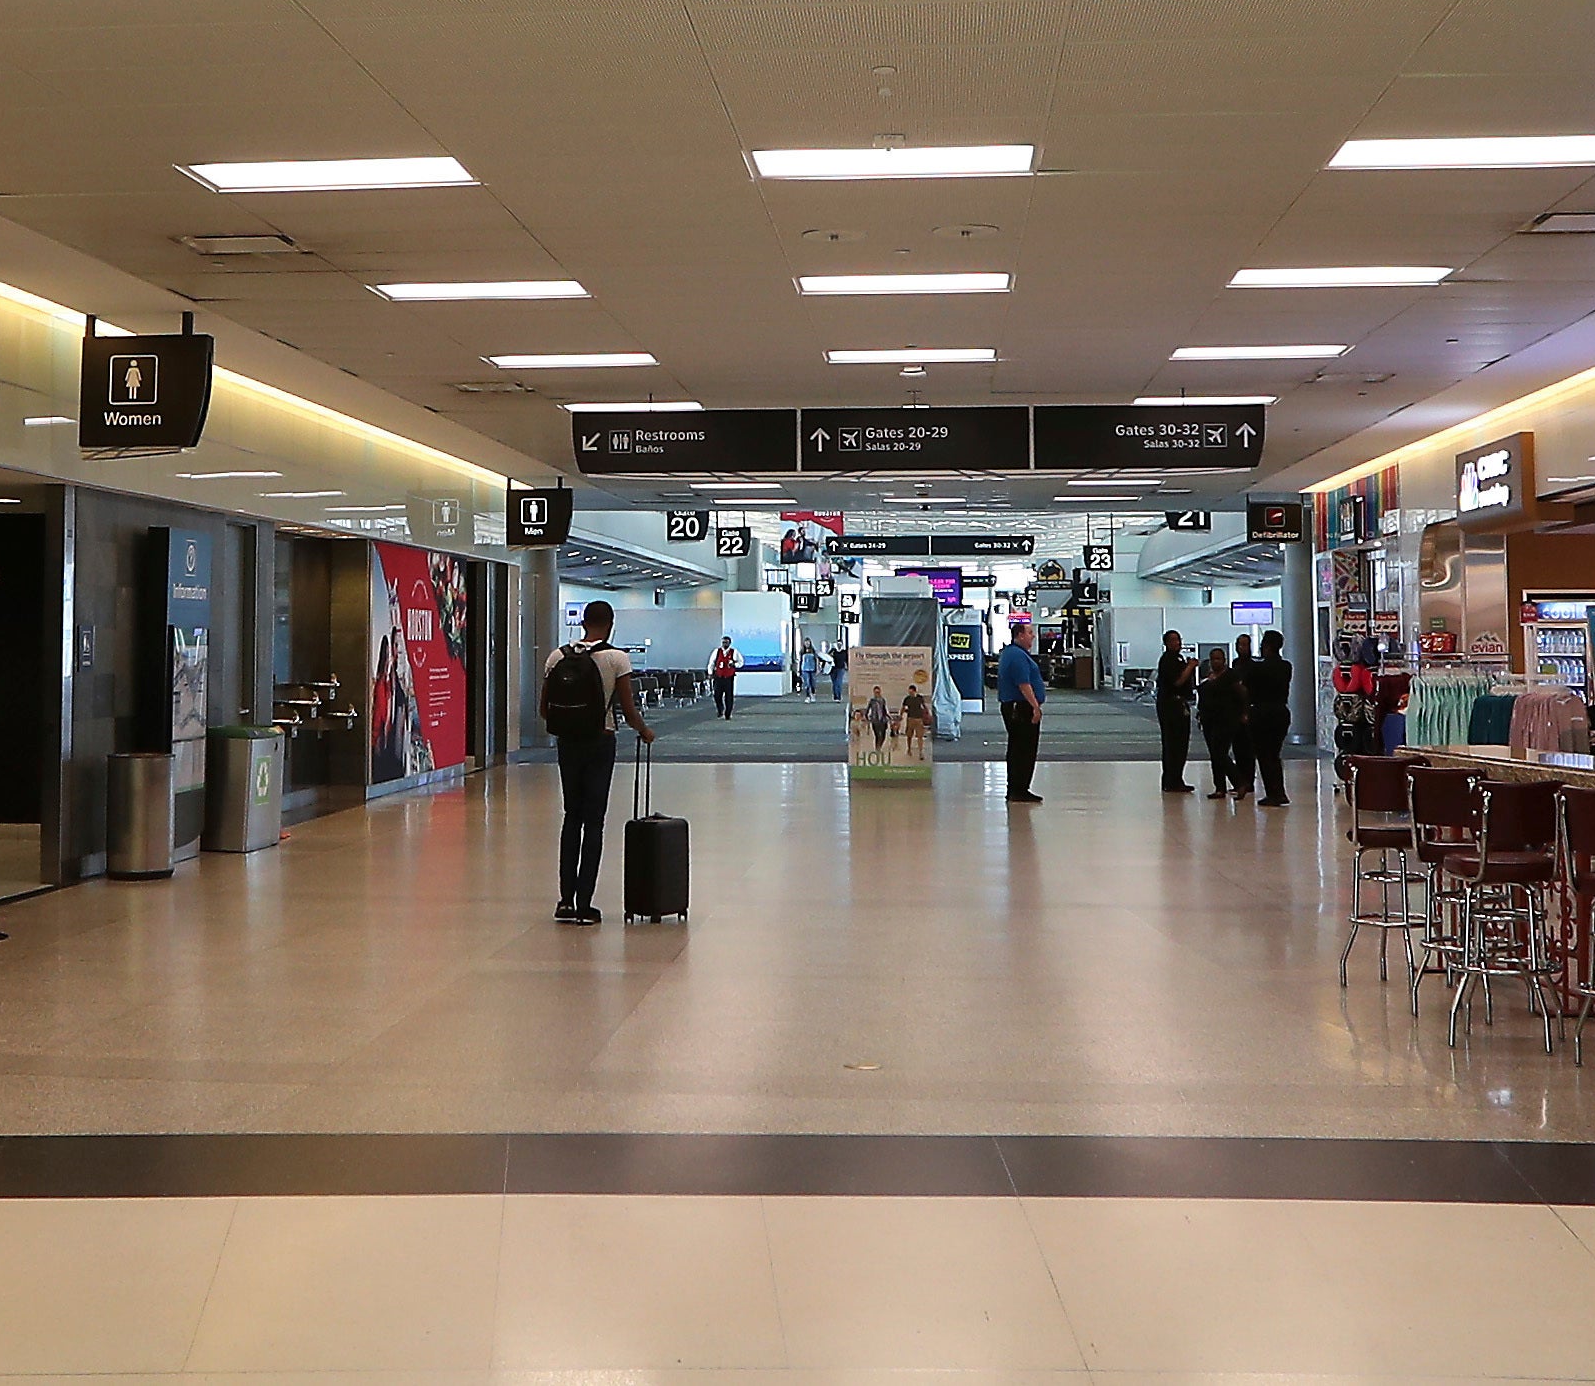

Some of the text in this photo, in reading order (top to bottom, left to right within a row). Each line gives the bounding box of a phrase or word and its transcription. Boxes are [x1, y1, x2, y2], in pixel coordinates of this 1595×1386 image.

[104, 411, 162, 426] Women
[635, 428, 706, 443] Restrooms
[865, 426, 949, 440] Gates 20-29
[1115, 423, 1200, 437] Gates 30-32
[635, 443, 665, 455] Baños
[865, 441, 922, 452] Salas 20-29
[1143, 438, 1201, 449] Salas 30-32
[524, 527, 544, 536] Men
[670, 516, 700, 538] 20
[1251, 531, 1300, 540] Defibrillator
[719, 537, 744, 555] 22
[1090, 553, 1112, 569] 23
[817, 584, 831, 596] 24
[1471, 642, 1504, 654] evian
[856, 751, 892, 767] HOU
